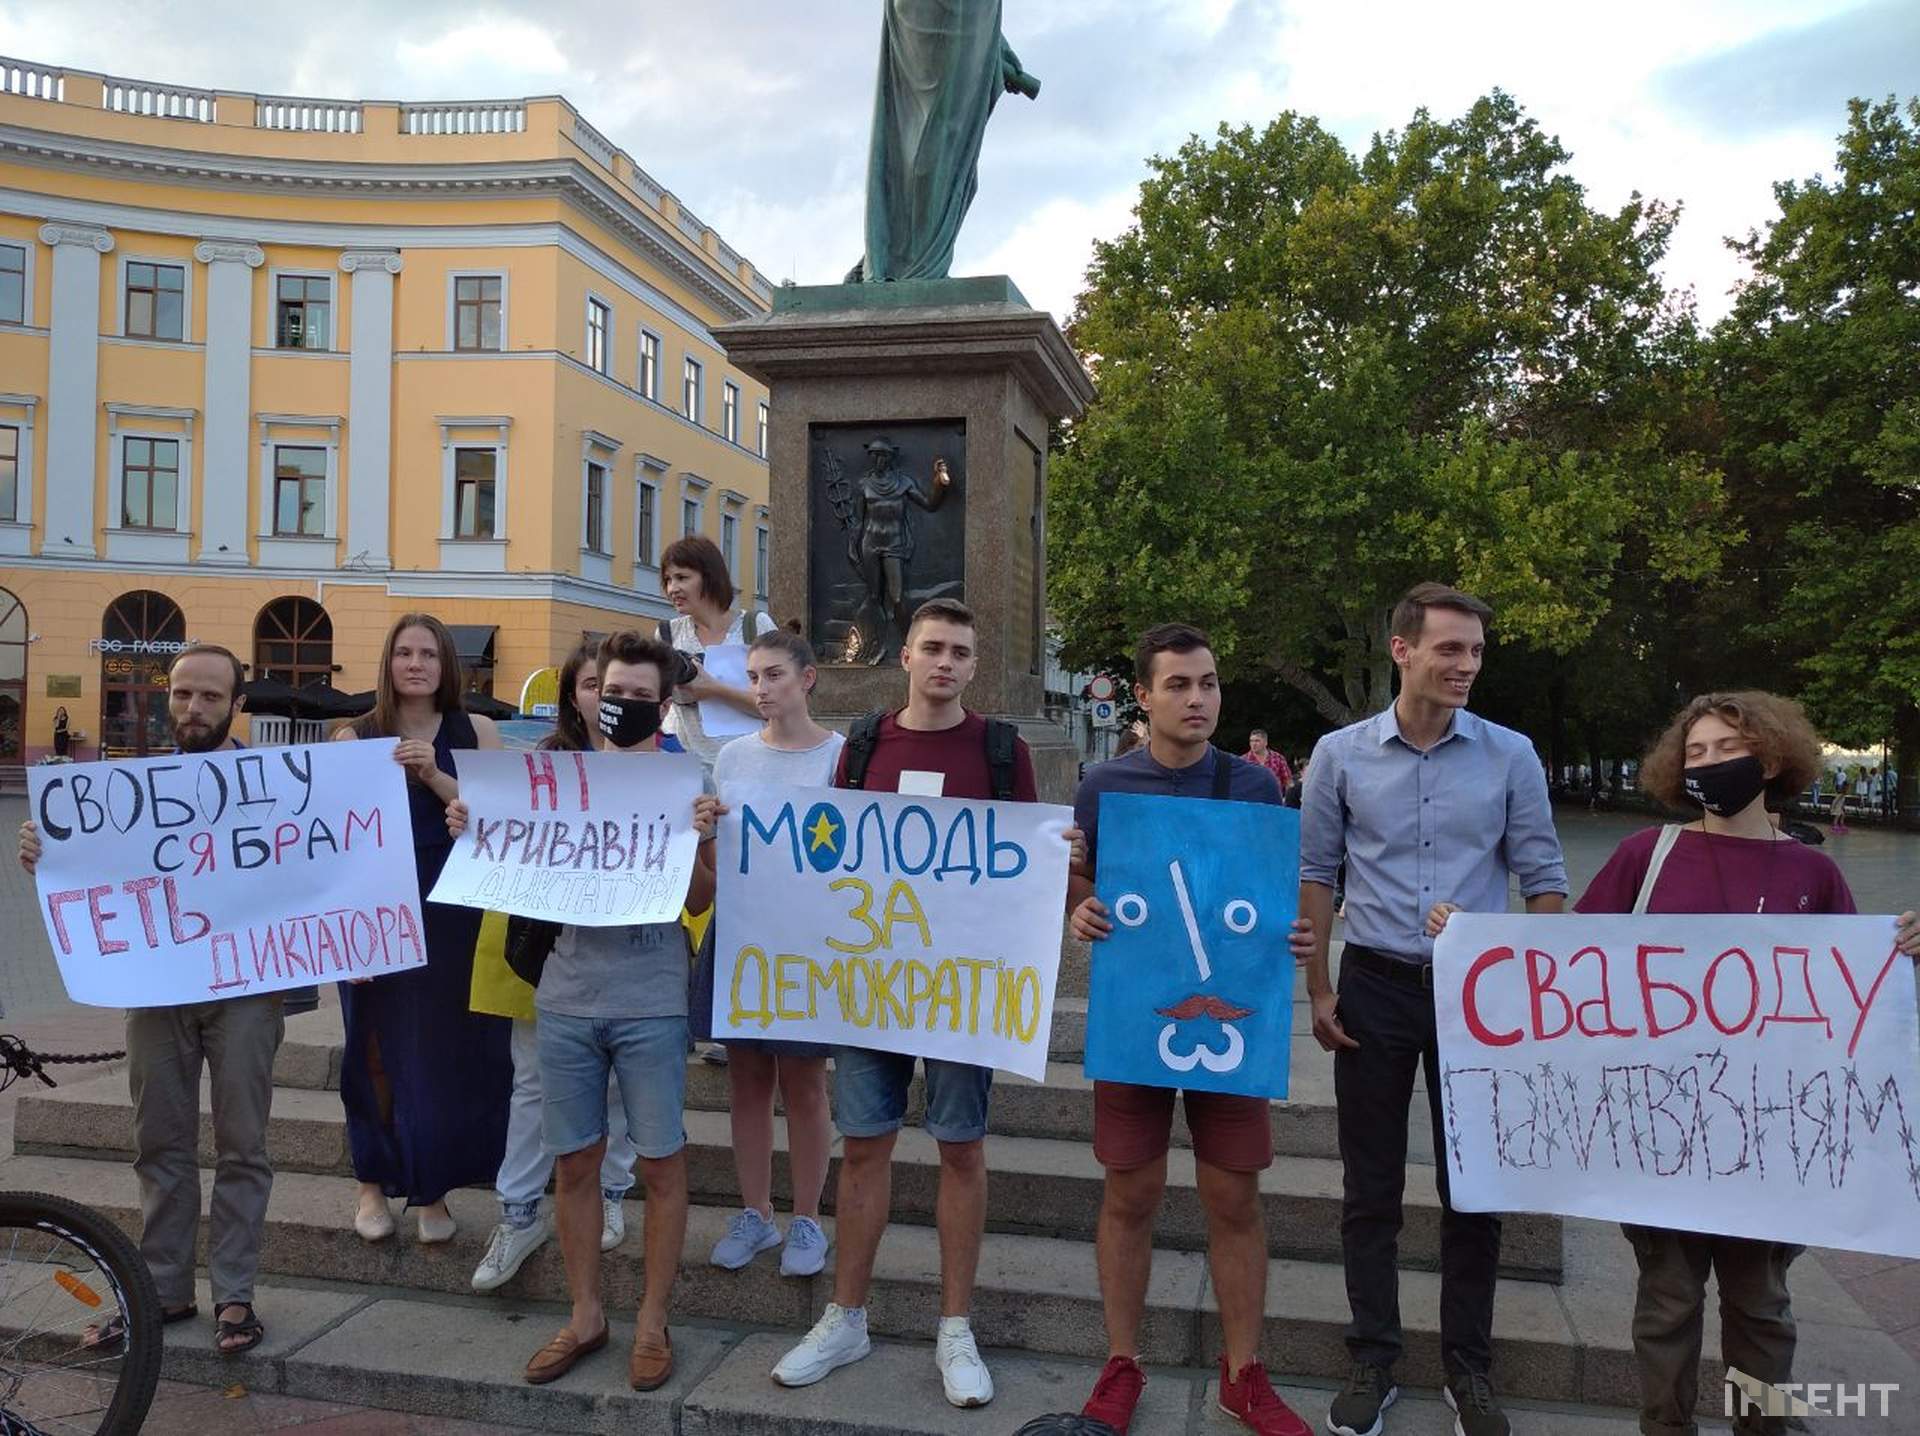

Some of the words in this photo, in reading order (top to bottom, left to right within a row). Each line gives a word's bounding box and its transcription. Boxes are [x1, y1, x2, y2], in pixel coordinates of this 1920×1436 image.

[89, 639, 122, 657] FOG
[40, 750, 313, 841] СВОБОДУ
[524, 753, 590, 811] НІ
[153, 807, 384, 876] СЯБРАМ
[470, 813, 672, 873] КРИВАВІЙ
[739, 801, 1028, 885] МОЛОДЬ
[47, 876, 211, 956] ГЕТЬ
[461, 865, 681, 916] ДИКТАТУРІ
[825, 877, 933, 954] ЗА
[207, 903, 425, 994] ДИКТАТОРА
[728, 943, 1042, 1045] ДЕМОКРАТІЮ
